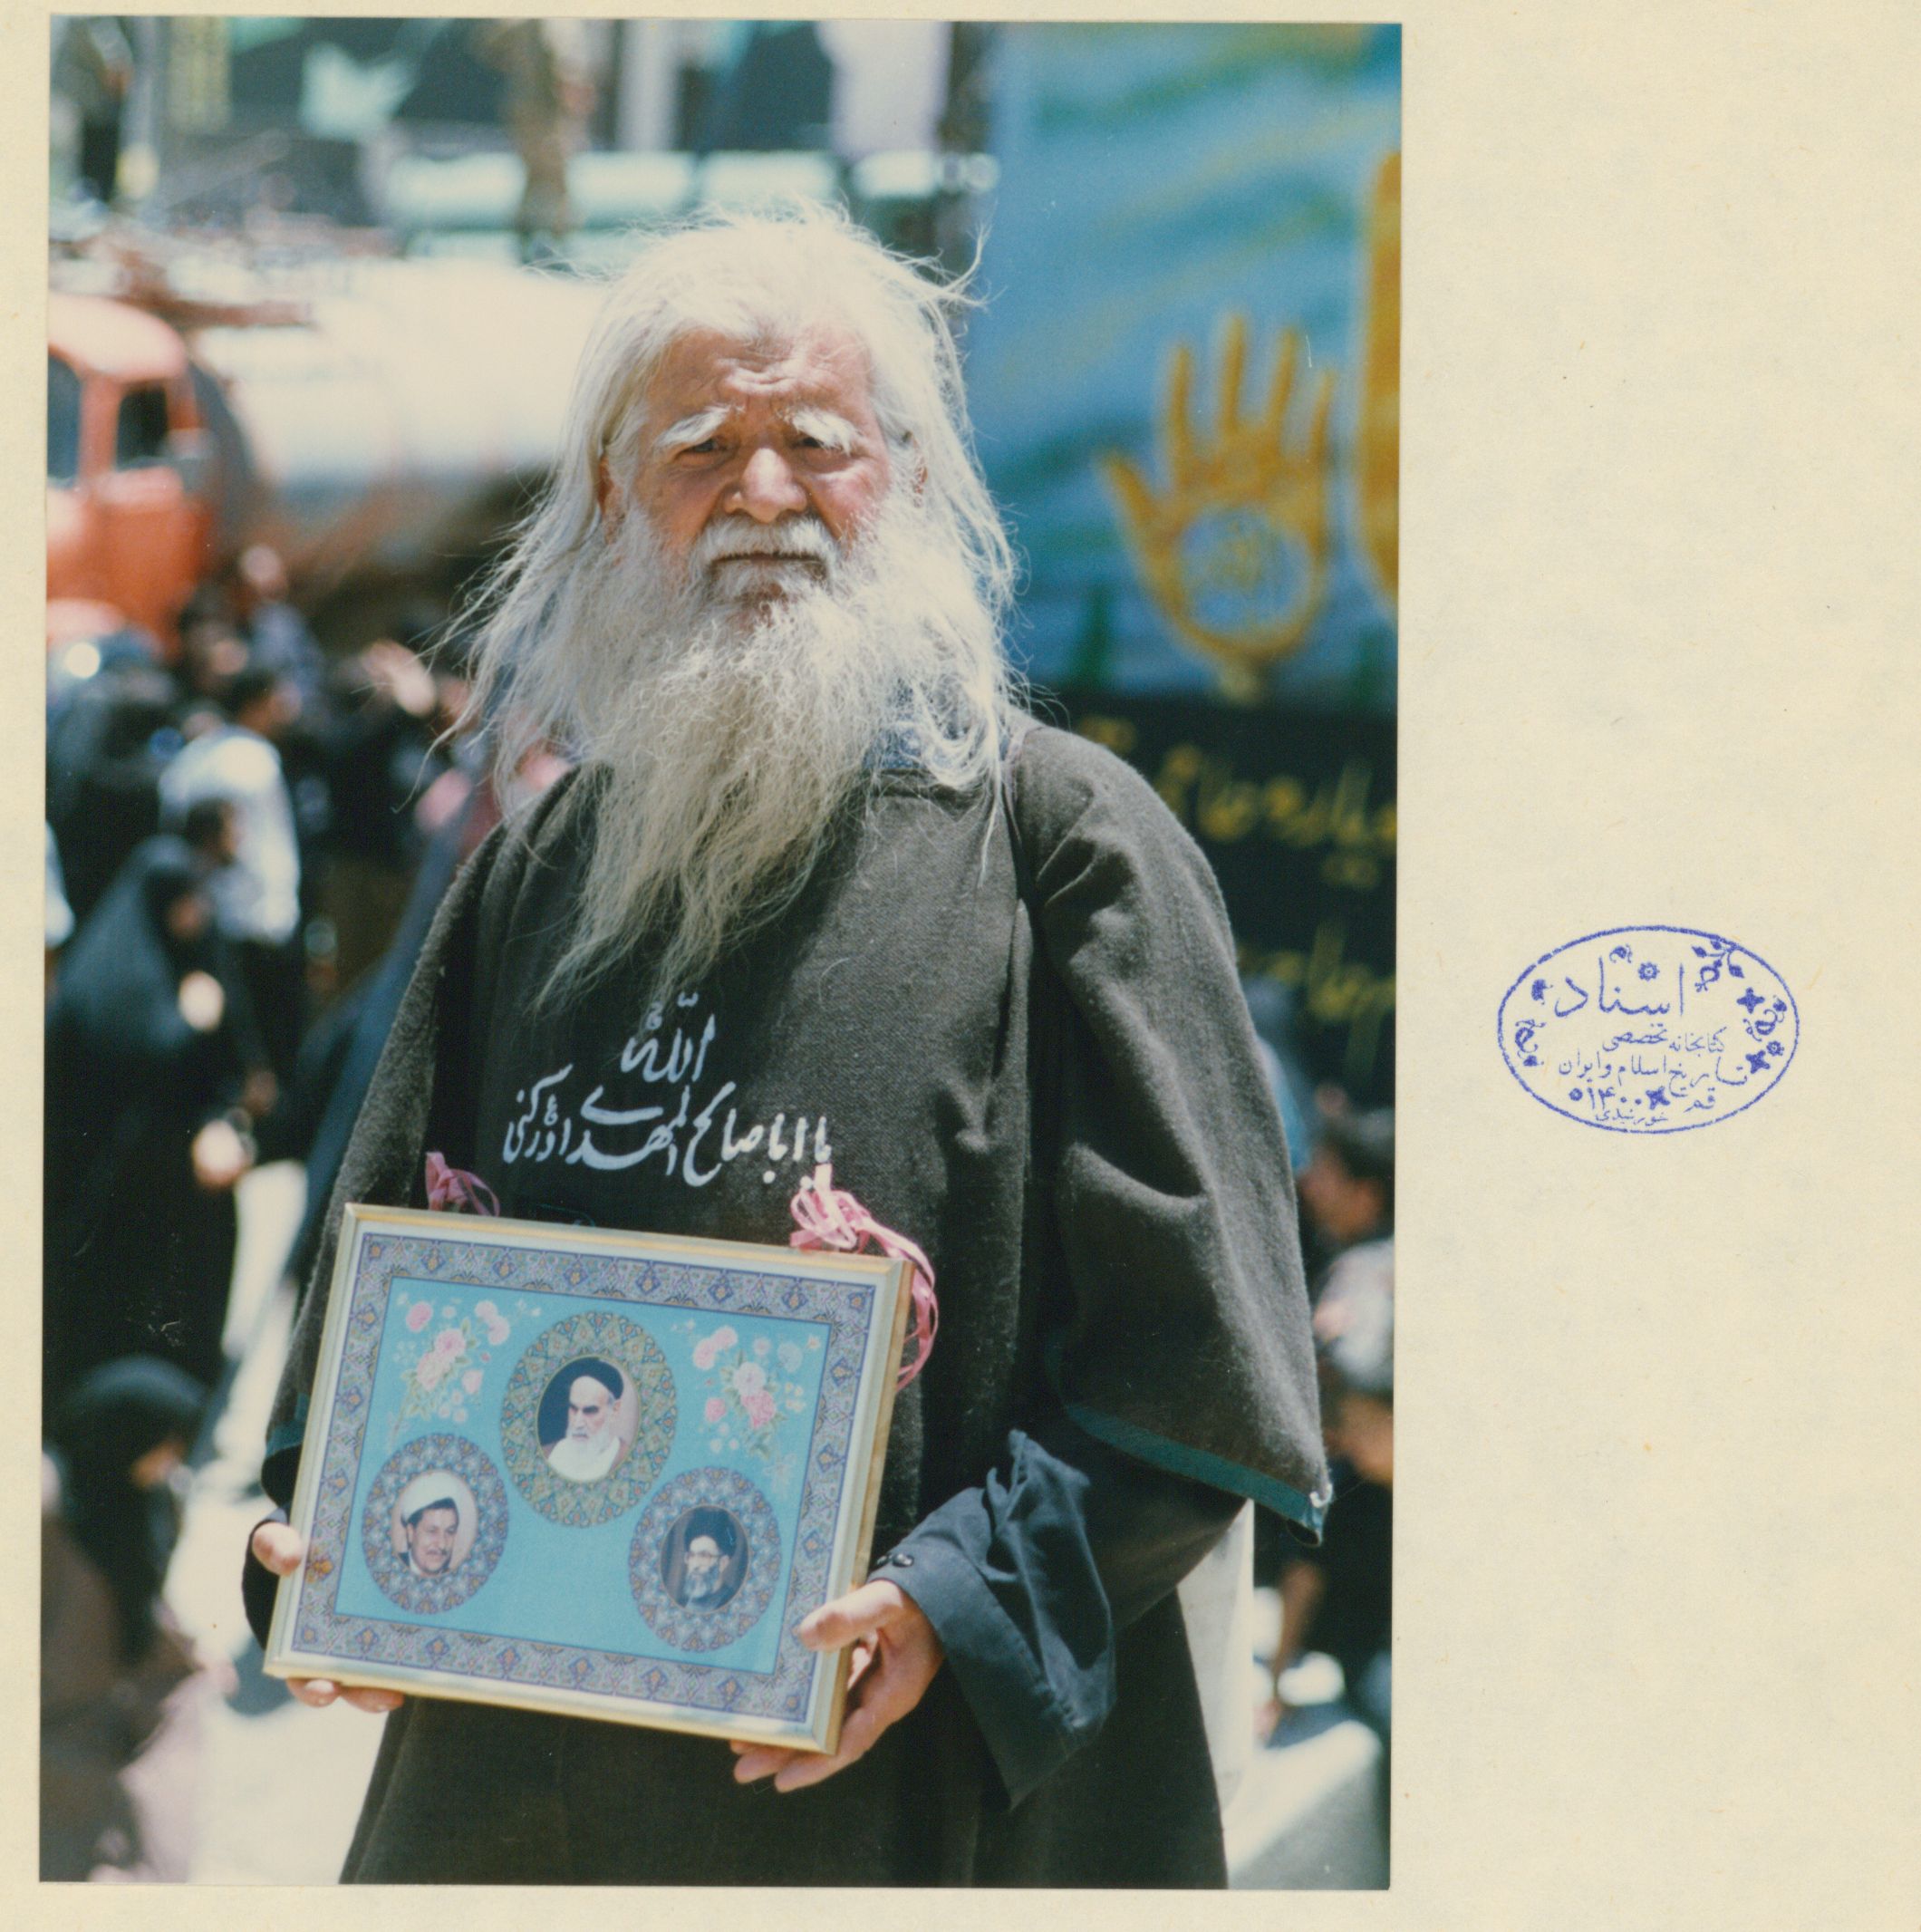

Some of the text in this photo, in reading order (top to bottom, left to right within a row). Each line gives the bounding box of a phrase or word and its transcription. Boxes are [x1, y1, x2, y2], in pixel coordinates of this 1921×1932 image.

[1553, 956, 1684, 1017] اسناد
[1601, 1023, 1728, 1058] کتابخانه تخصصی
[1559, 1048, 1601, 1083] ایران
[1617, 1054, 1667, 1087] اسلام
[1668, 1056, 1749, 1097] تاریخ
[1683, 1087, 1716, 1114] قم
